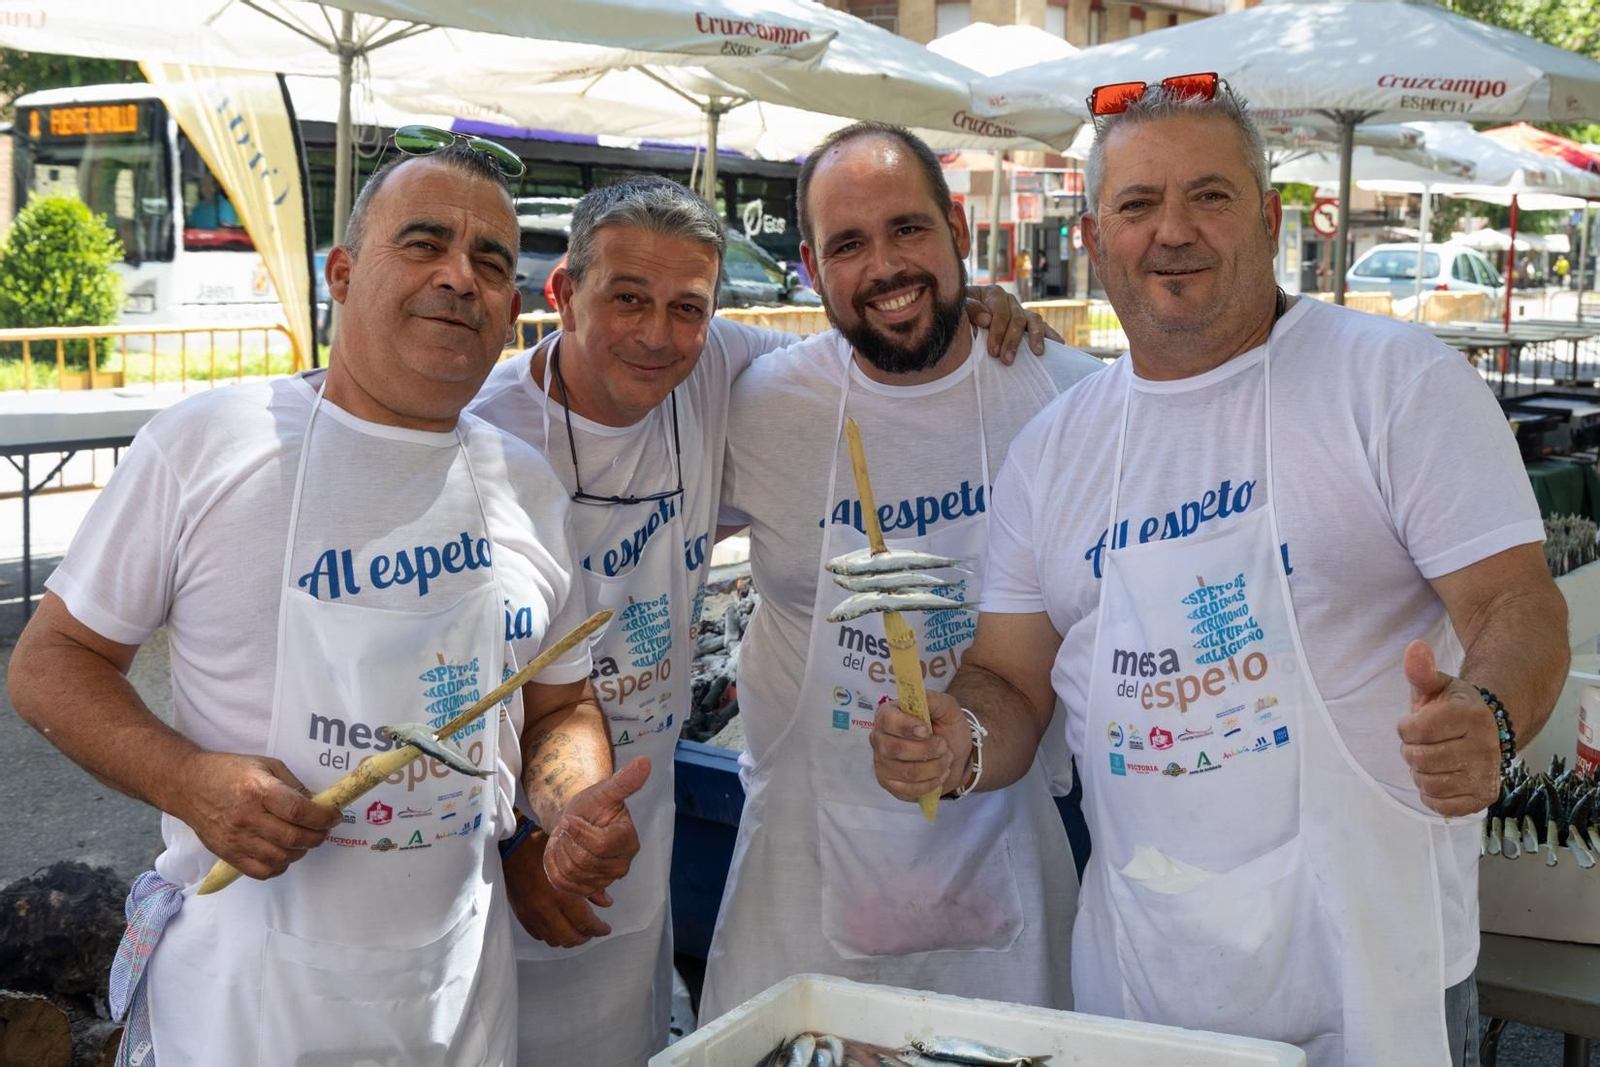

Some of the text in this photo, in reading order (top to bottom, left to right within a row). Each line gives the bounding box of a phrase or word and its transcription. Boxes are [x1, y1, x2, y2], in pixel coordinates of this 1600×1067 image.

[1377, 73, 1506, 99] Cruzcampo
[952, 109, 1017, 138] Cruzcam
[298, 532, 492, 599] Al espeto
[838, 625, 892, 659] mes
[843, 653, 865, 671] del
[1112, 648, 1180, 677] mesa
[1117, 679, 1139, 698] del
[319, 749, 350, 770] del
[1127, 764, 1159, 772] VICTORIA
